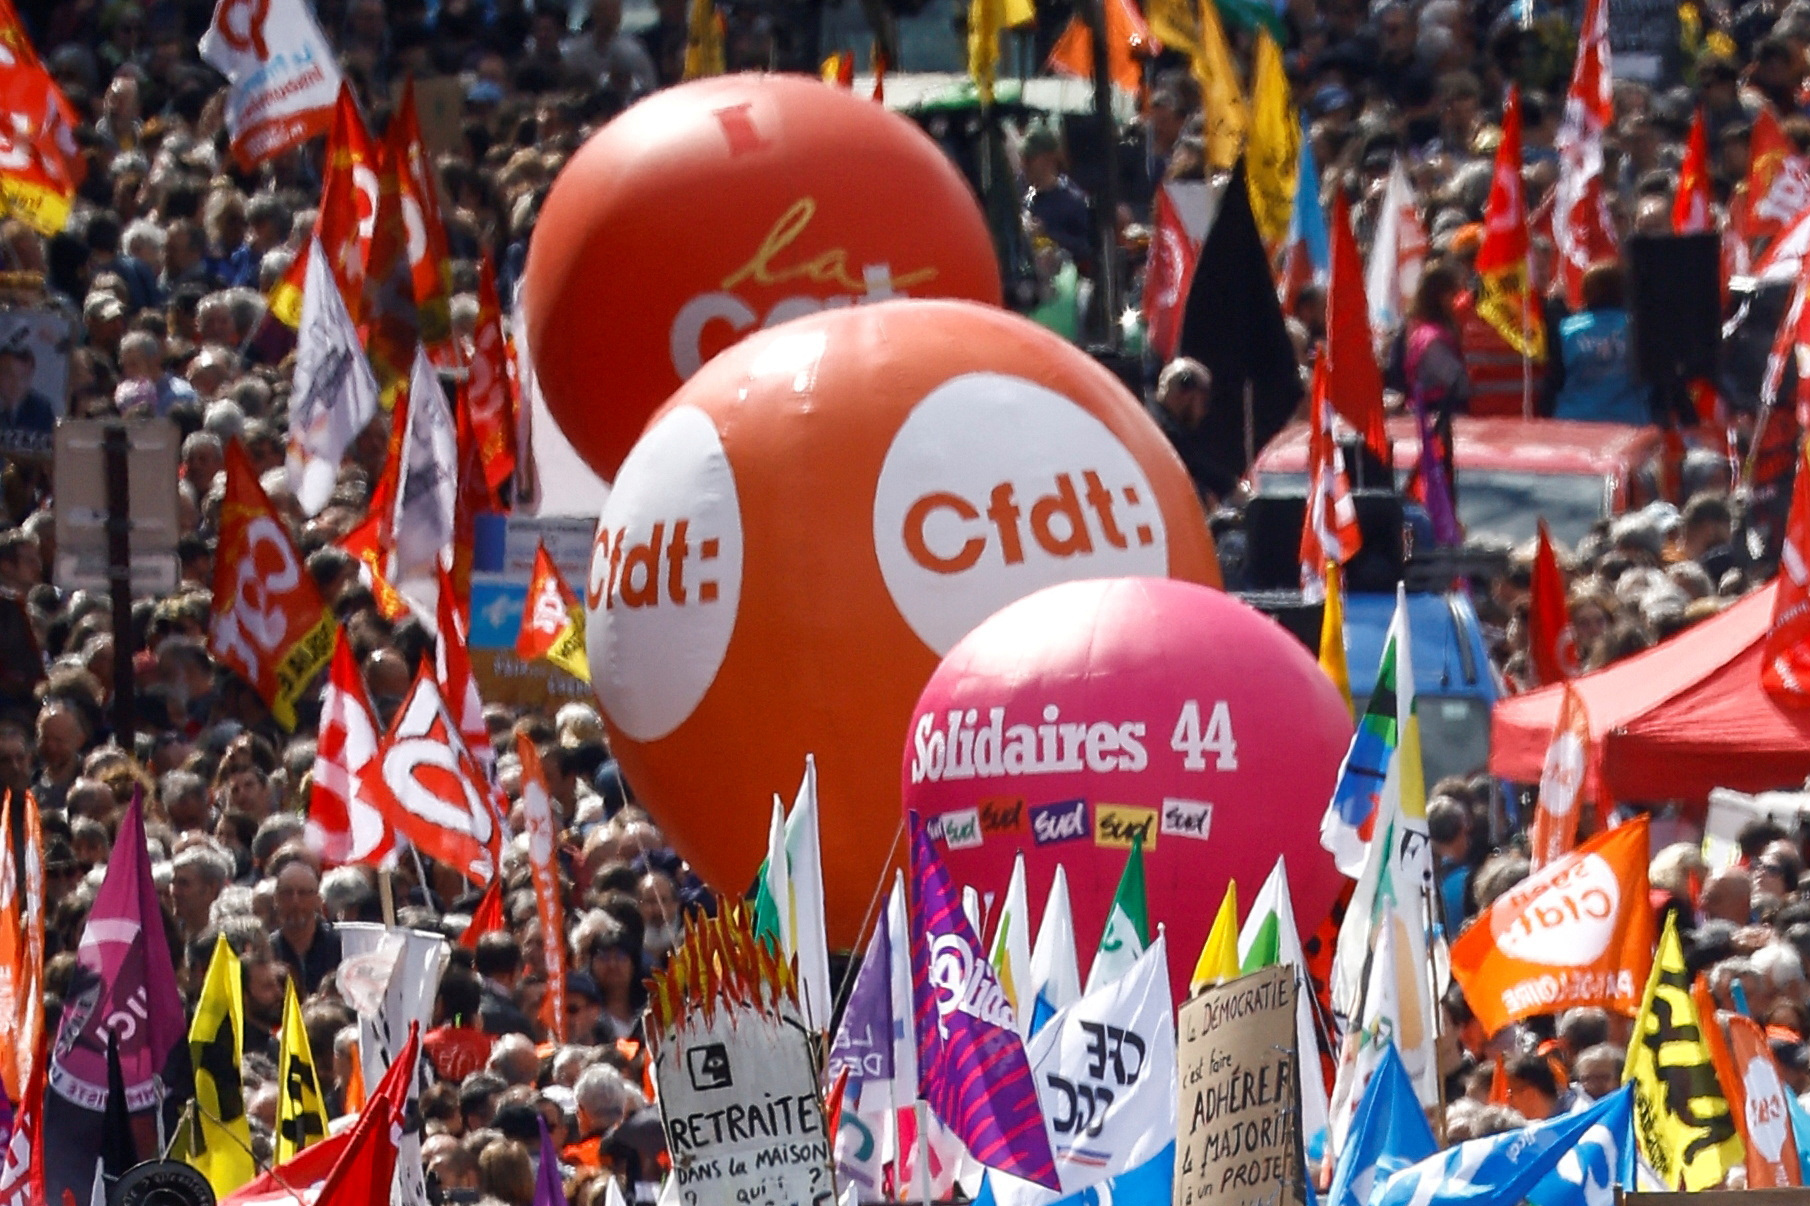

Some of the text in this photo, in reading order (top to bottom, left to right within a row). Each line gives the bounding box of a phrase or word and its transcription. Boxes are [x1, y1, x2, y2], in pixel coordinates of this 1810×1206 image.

[902, 469, 1154, 576] Cfdt:
[912, 699, 1238, 784] Solidaires 44
[677, 1163, 722, 1186] DANS
[755, 1141, 827, 1169] MAISON
